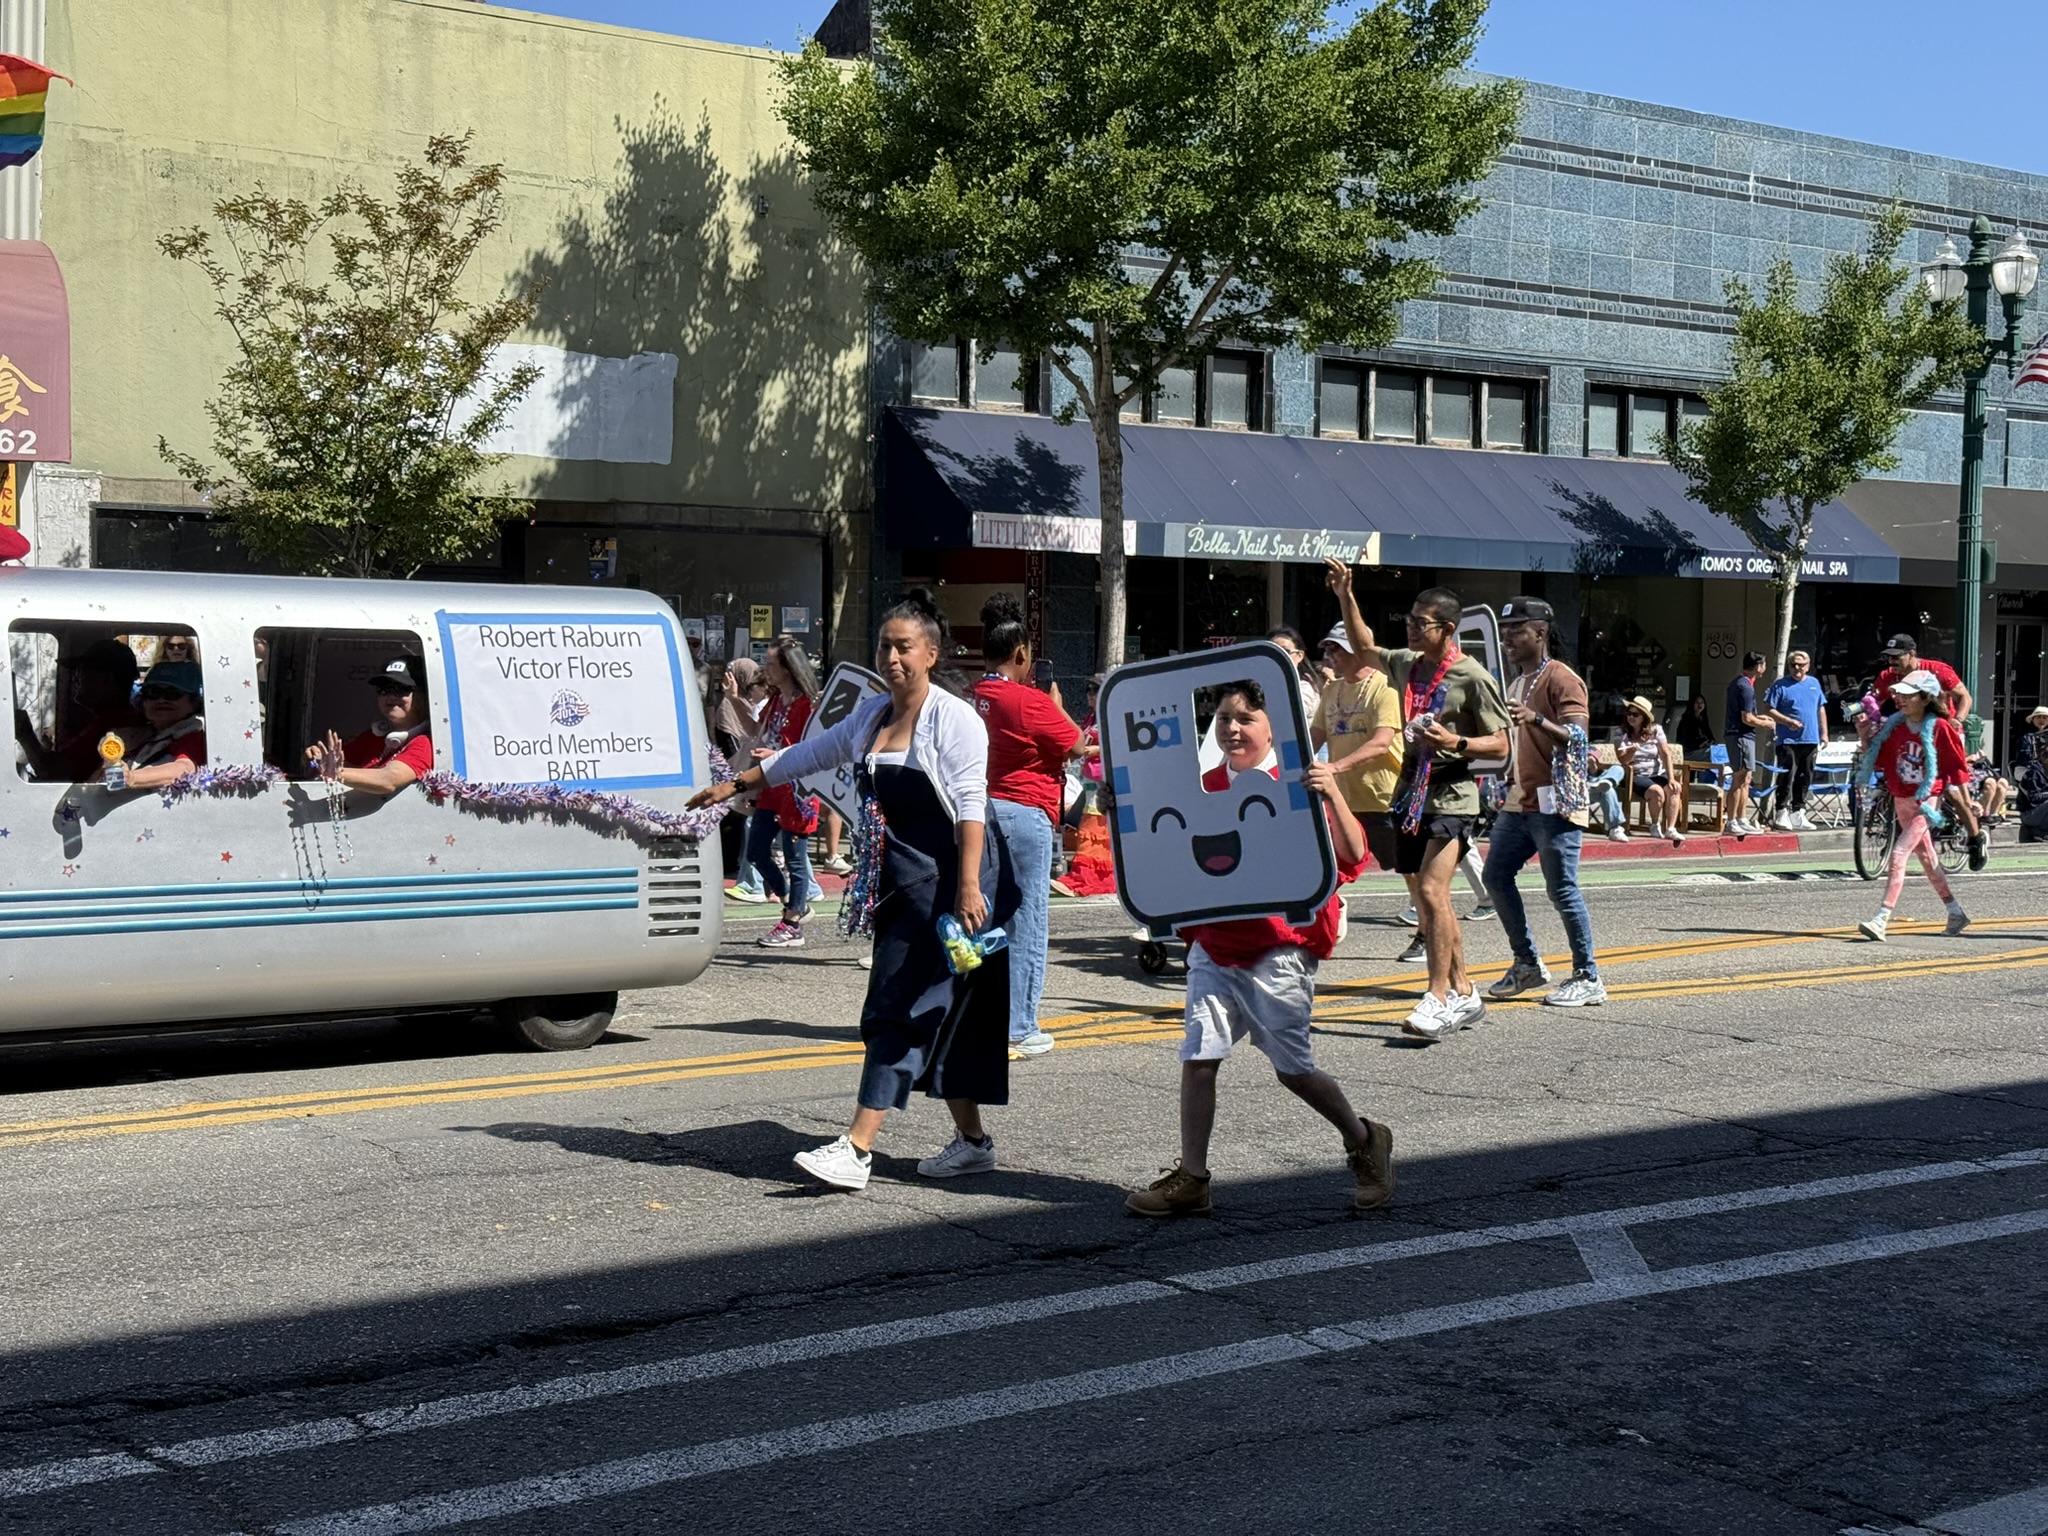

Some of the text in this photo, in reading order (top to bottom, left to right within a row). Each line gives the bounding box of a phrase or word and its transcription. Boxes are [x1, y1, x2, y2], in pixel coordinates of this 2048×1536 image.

[980, 519, 1029, 546] LITTLE
[1187, 527, 1231, 553] Bella
[1231, 529, 1269, 557] Nail
[1269, 534, 1295, 560] Spa
[1299, 533, 1312, 557] &
[1700, 556, 1743, 573] TOMO'S
[1801, 560, 1826, 575] NAIL
[1829, 562, 1848, 576] SPA
[479, 624, 642, 648] Robert Raburn
[496, 655, 633, 680] Victor Flores
[1138, 704, 1178, 718] BART
[493, 732, 653, 757] Board Members
[547, 759, 601, 782] BART
